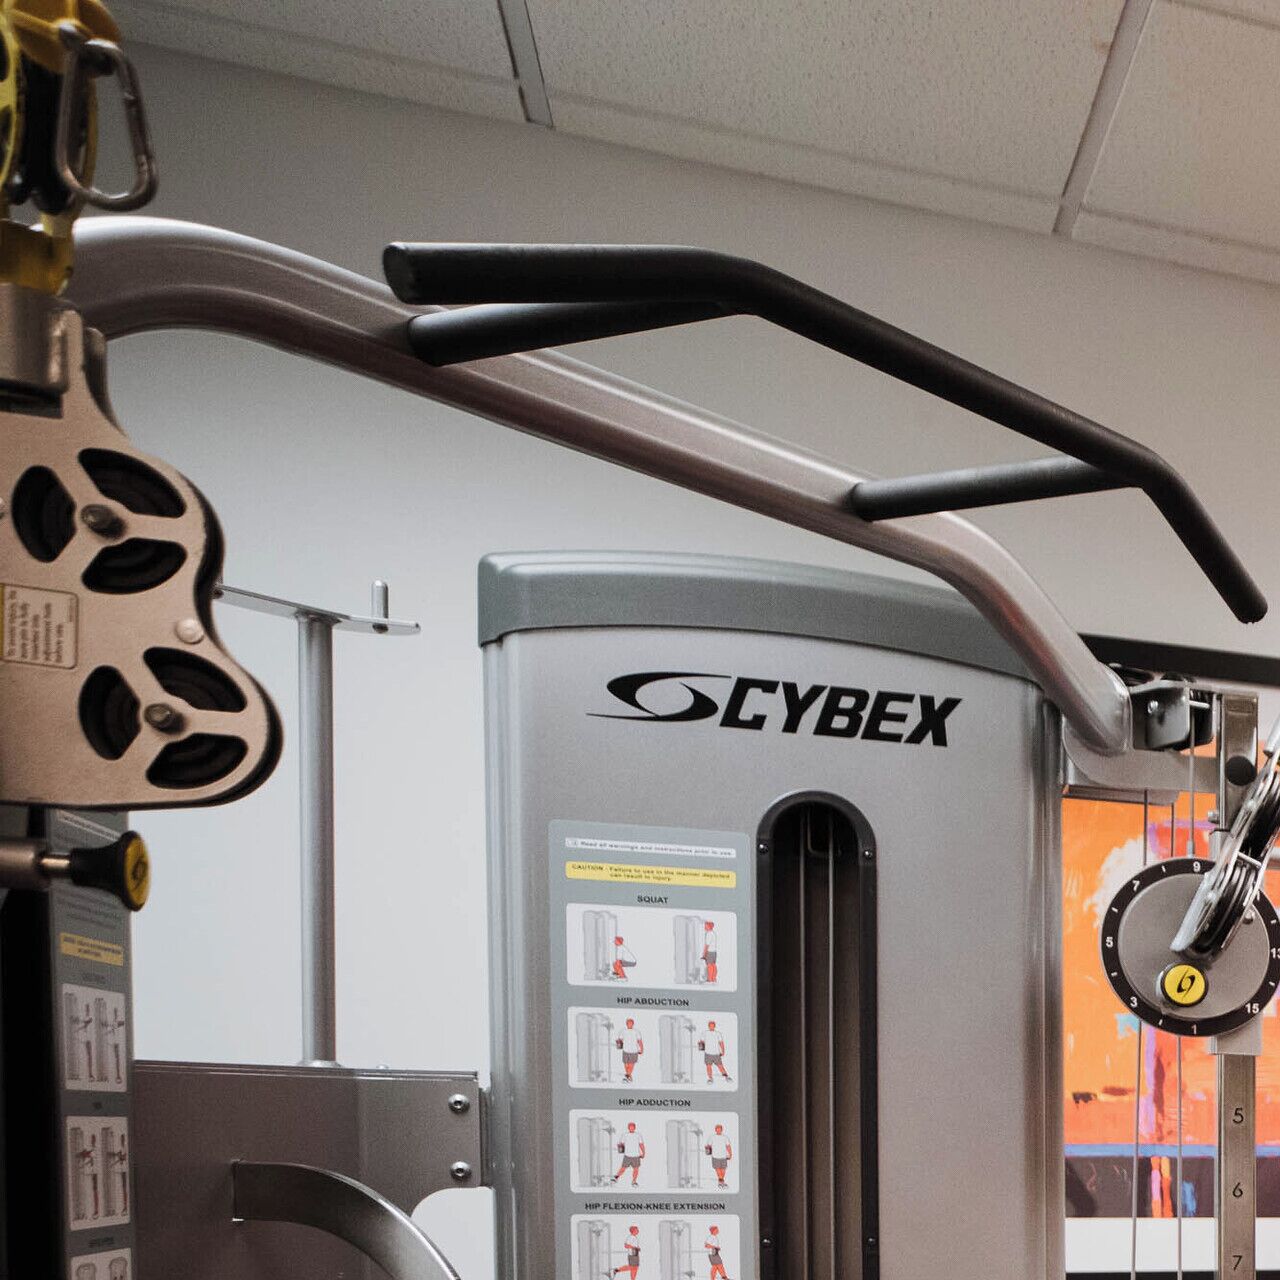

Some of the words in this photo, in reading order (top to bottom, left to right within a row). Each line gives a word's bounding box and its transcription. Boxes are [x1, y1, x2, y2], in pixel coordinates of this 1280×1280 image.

[719, 678, 963, 748] CYBEX
[1193, 862, 1200, 872] 9
[1132, 880, 1140, 891] 7
[637, 895, 669, 904] SQUAT
[1106, 937, 1114, 947] 5
[634, 998, 690, 1007] ABDUCTION
[1130, 996, 1138, 1007] 3
[1245, 1002, 1260, 1014] 15
[619, 1098, 635, 1106] HIP
[636, 1099, 691, 1107] ADDUCTION
[1232, 1108, 1244, 1125] 5
[1232, 1182, 1243, 1198] 6
[603, 1202, 671, 1210] FLEXION-KNEE
[674, 1203, 725, 1211] EXTENSION
[1232, 1255, 1243, 1271] 7
